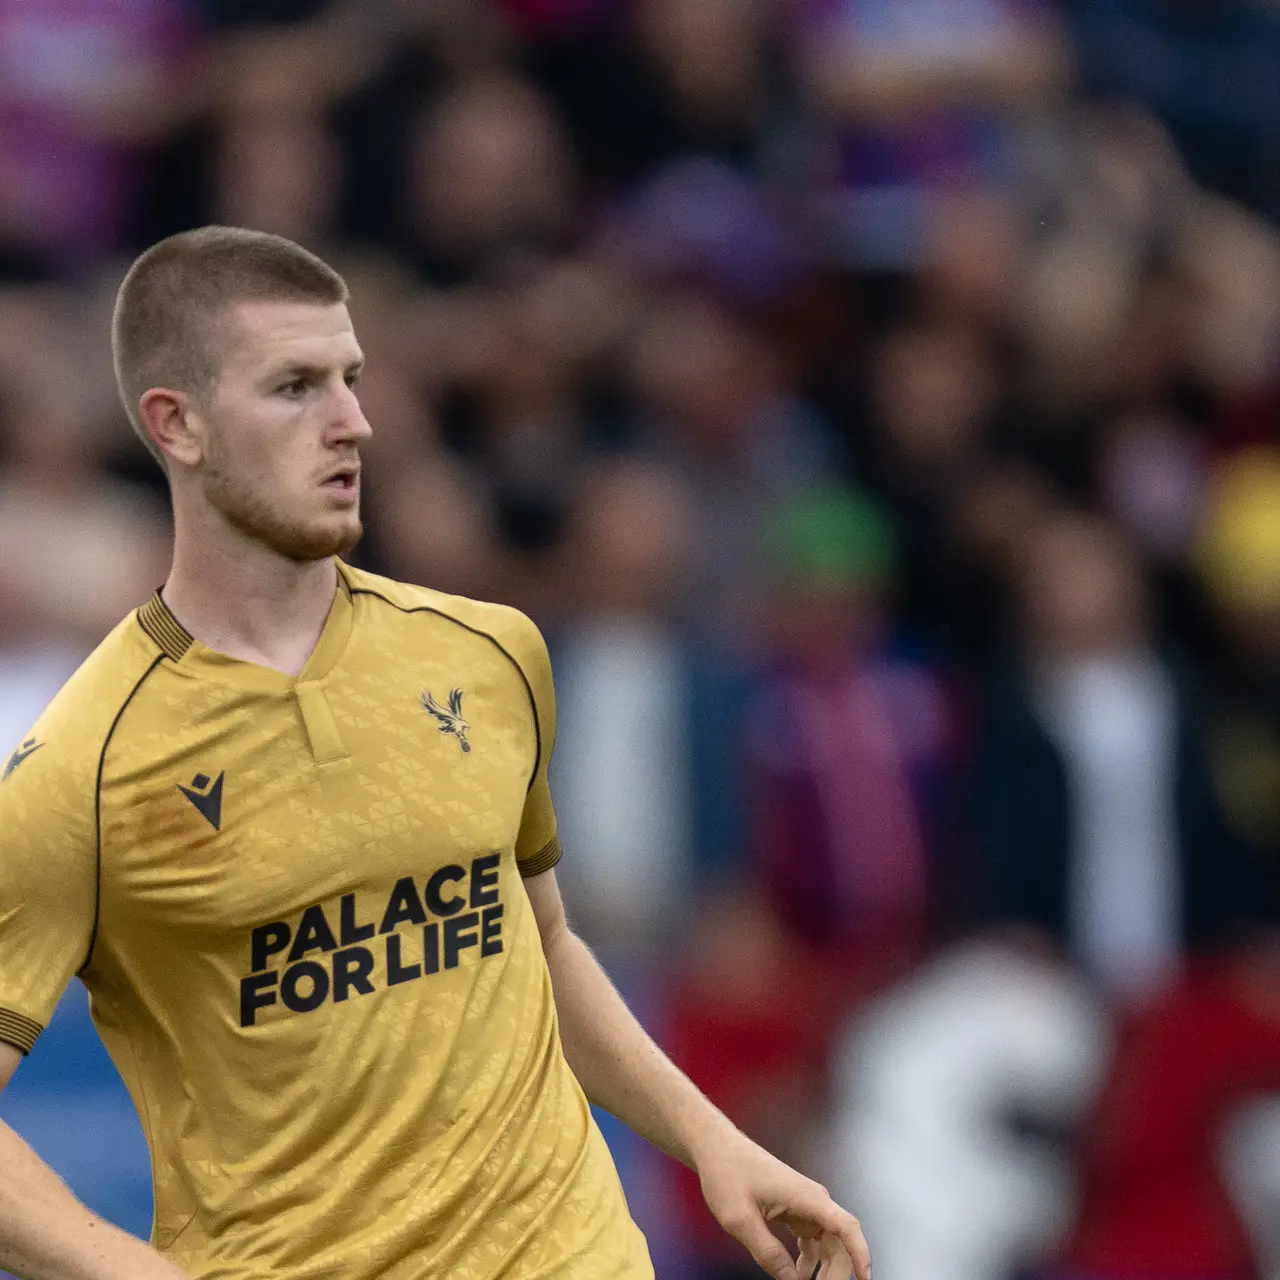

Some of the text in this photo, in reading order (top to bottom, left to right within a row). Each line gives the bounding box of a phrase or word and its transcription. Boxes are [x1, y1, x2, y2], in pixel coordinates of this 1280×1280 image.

[240, 903, 504, 1027] FOR LIFE
[250, 852, 501, 972] PALACE
